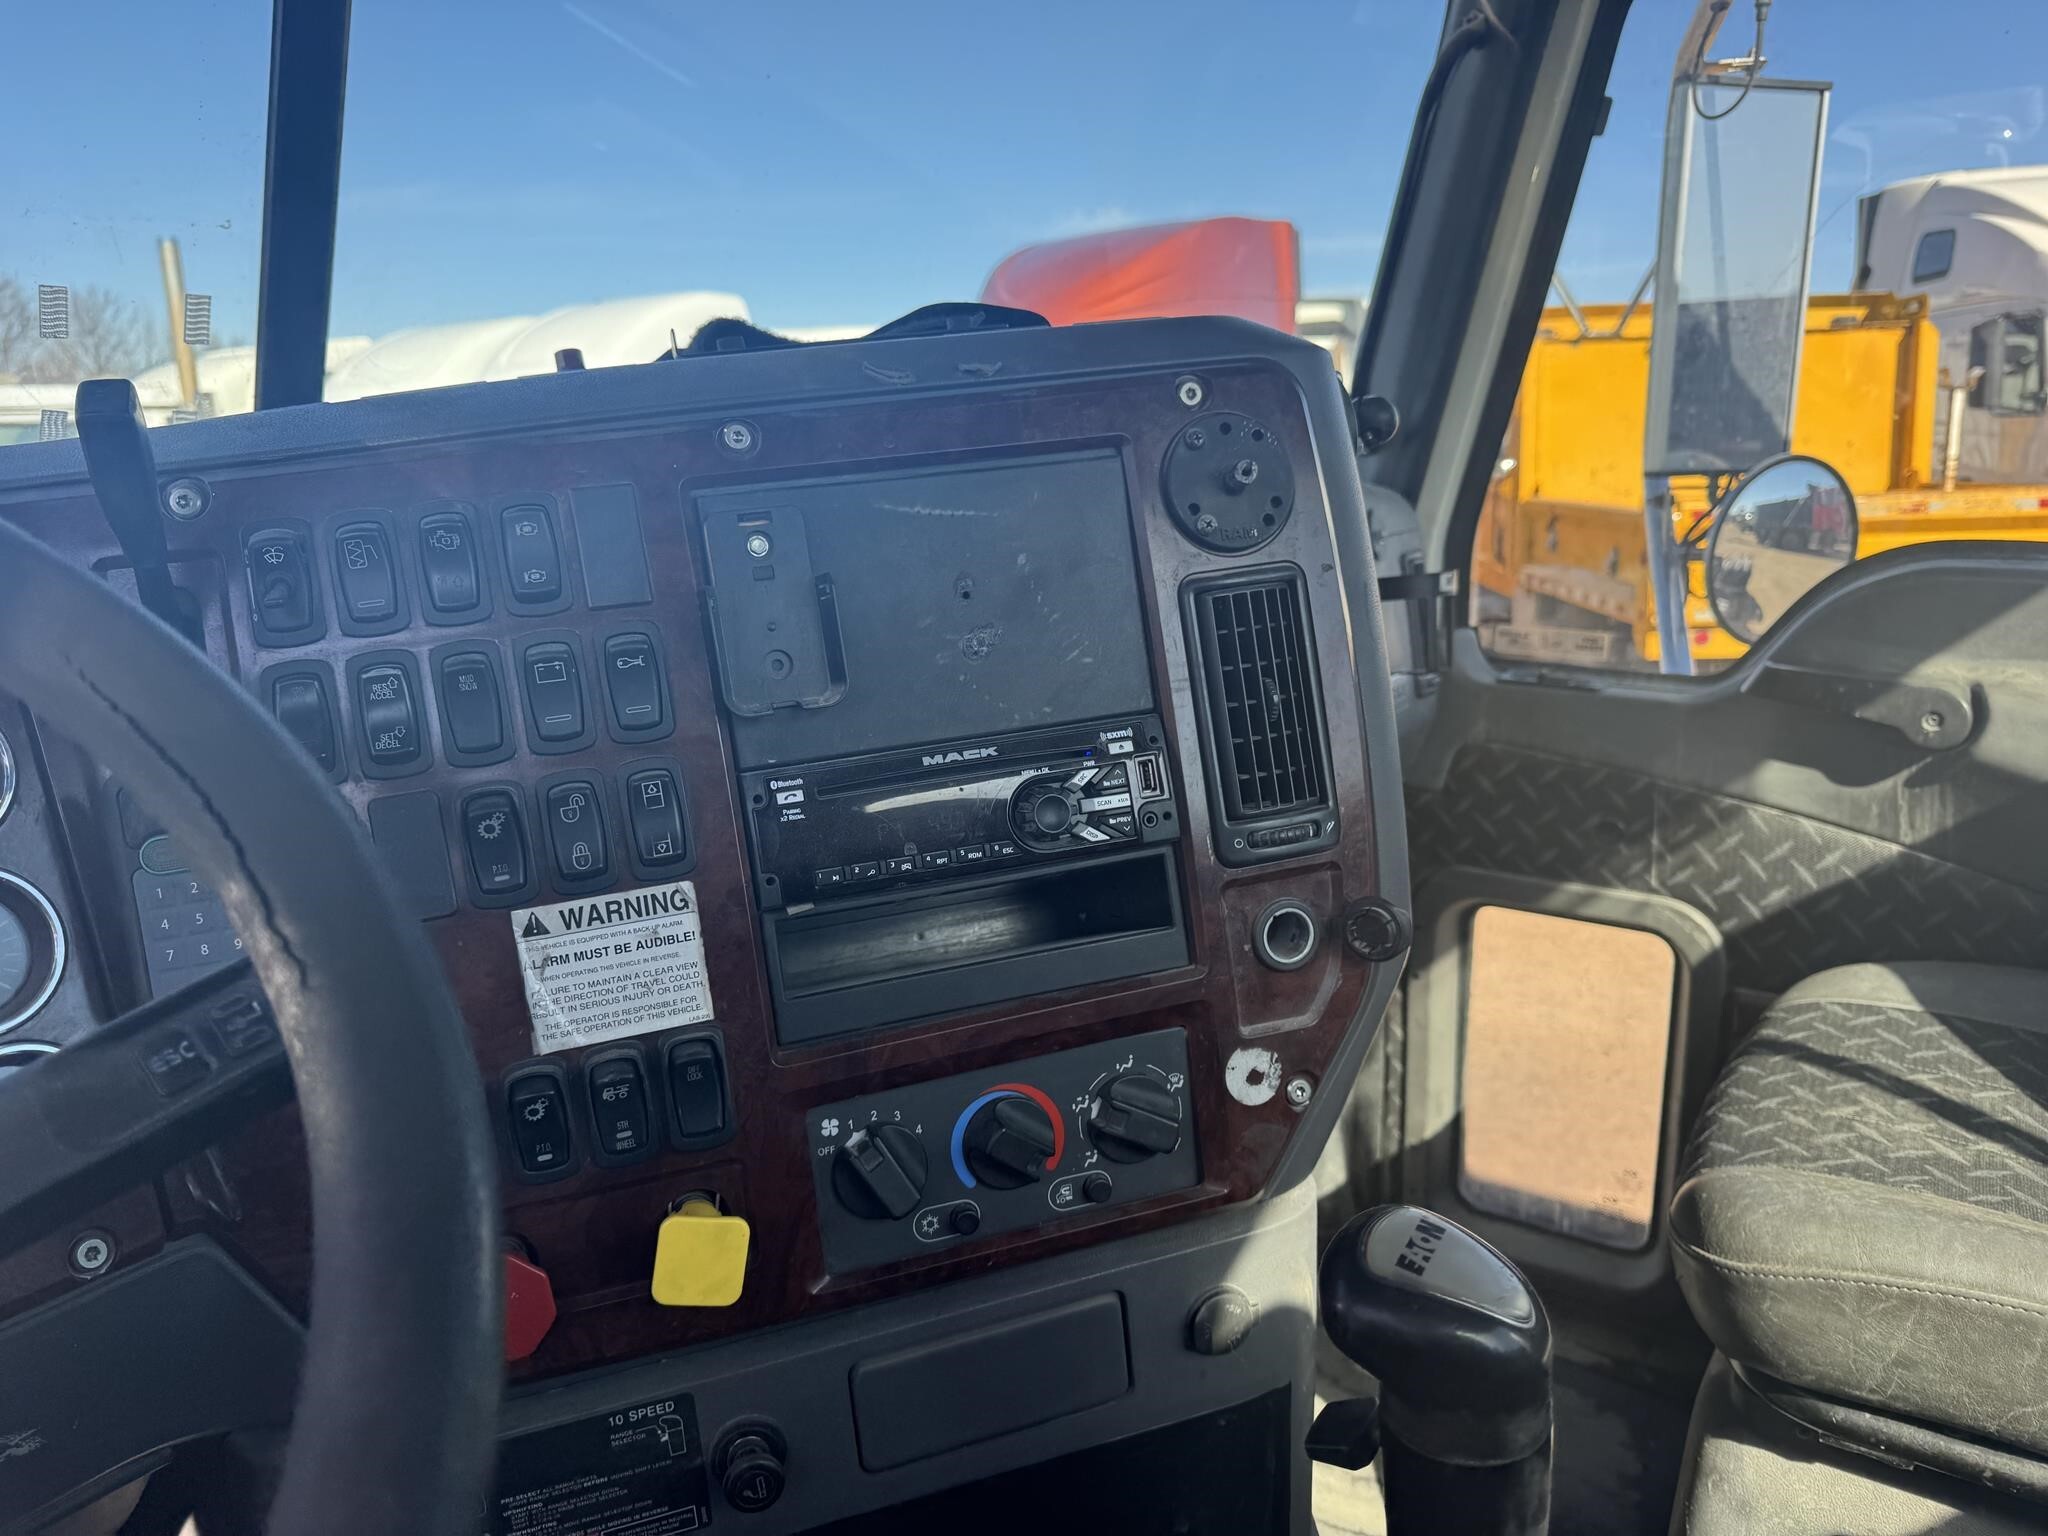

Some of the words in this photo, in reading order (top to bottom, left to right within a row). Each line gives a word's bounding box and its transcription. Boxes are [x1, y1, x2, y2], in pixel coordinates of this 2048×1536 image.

[370, 690, 396, 701] ACCEL
[379, 733, 396, 743] SET
[375, 740, 401, 751] DECEL
[922, 747, 999, 766] MACK
[777, 778, 803, 788] Bluetooth
[1110, 778, 1126, 786] NEXT
[1096, 799, 1112, 807] SCAN
[960, 849, 965, 857] 5
[968, 851, 983, 860] RDM
[1002, 846, 1014, 854] ESC
[926, 854, 931, 862] 4
[936, 857, 949, 865] RPT
[155, 888, 163, 899] 1
[190, 882, 199, 894] 2
[559, 888, 690, 931] WARNING
[160, 919, 170, 930] 4
[195, 913, 204, 925] 5
[577, 932, 609, 944] EQUIPPED
[610, 928, 627, 938] WITH
[165, 950, 174, 962] 7
[200, 944, 209, 956] 8
[234, 937, 243, 950] 9
[574, 945, 611, 962] MUST
[614, 942, 633, 955] BE
[636, 930, 696, 951] AUDIBLE!
[540, 974, 561, 983] WHEN
[561, 967, 599, 979] OPERATING
[600, 962, 615, 972] THIS
[615, 959, 641, 970] VEHICLE
[573, 982, 586, 992] TO
[587, 974, 633, 989] MAINTAIN
[634, 972, 641, 980] A
[642, 965, 675, 978] CLEAR
[675, 961, 699, 972] VIEW
[564, 987, 614, 1004] DIRECTION
[616, 985, 630, 994] OF
[631, 978, 667, 990] TRAVEL
[669, 971, 700, 983] COULD
[568, 1004, 578, 1013] IN
[579, 996, 621, 1011] SERIOUS
[622, 989, 655, 1002] INJURY
[657, 986, 671, 995] OR
[545, 1020, 562, 1032] THE
[564, 1012, 610, 1028] OPERATOR
[611, 1010, 620, 1018] IS
[621, 998, 680, 1016] RESPONSIBLE
[680, 995, 698, 1005] FOR
[541, 1032, 559, 1041] THE
[560, 1027, 582, 1038] SAFE
[583, 1016, 632, 1034] OPERATION
[633, 1014, 645, 1024] OF
[647, 1010, 666, 1020] THIS
[870, 1110, 879, 1121] 2
[893, 1110, 902, 1121] 3
[848, 1118, 854, 1130] 1
[915, 1124, 923, 1135] 4
[616, 1138, 637, 1151] WHEEL
[817, 1144, 836, 1157] OFF
[608, 1414, 624, 1427] 10
[628, 1401, 675, 1422] SPEED
